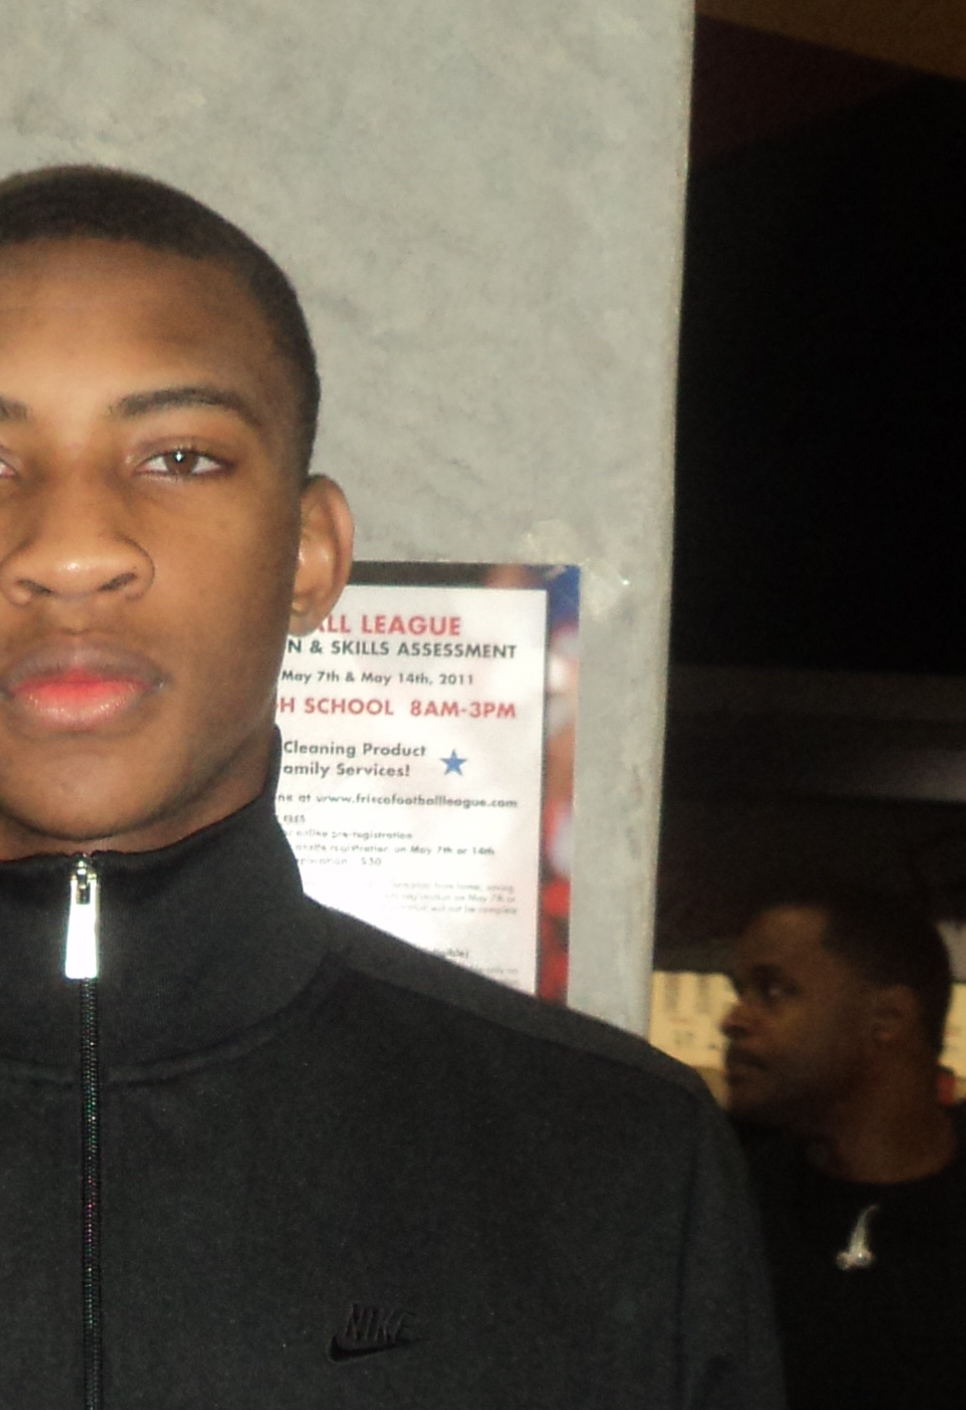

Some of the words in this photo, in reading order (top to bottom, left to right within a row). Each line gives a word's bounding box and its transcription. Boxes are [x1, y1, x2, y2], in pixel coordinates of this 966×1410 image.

[361, 613, 461, 636] LEAGUE
[309, 639, 323, 654] &
[331, 640, 390, 656] SKILLS
[397, 641, 517, 659] ASSESSMENT
[281, 669, 312, 685] May
[317, 669, 340, 683] 7th
[345, 671, 355, 683] &
[361, 671, 392, 687] May
[398, 672, 433, 686] 14th,
[439, 673, 474, 686] 2011
[304, 697, 394, 716] SCHOOL
[410, 698, 517, 719] 8AM-3PM
[283, 740, 357, 759] Cleaning
[362, 742, 428, 757] Product
[336, 761, 412, 778] Services!
